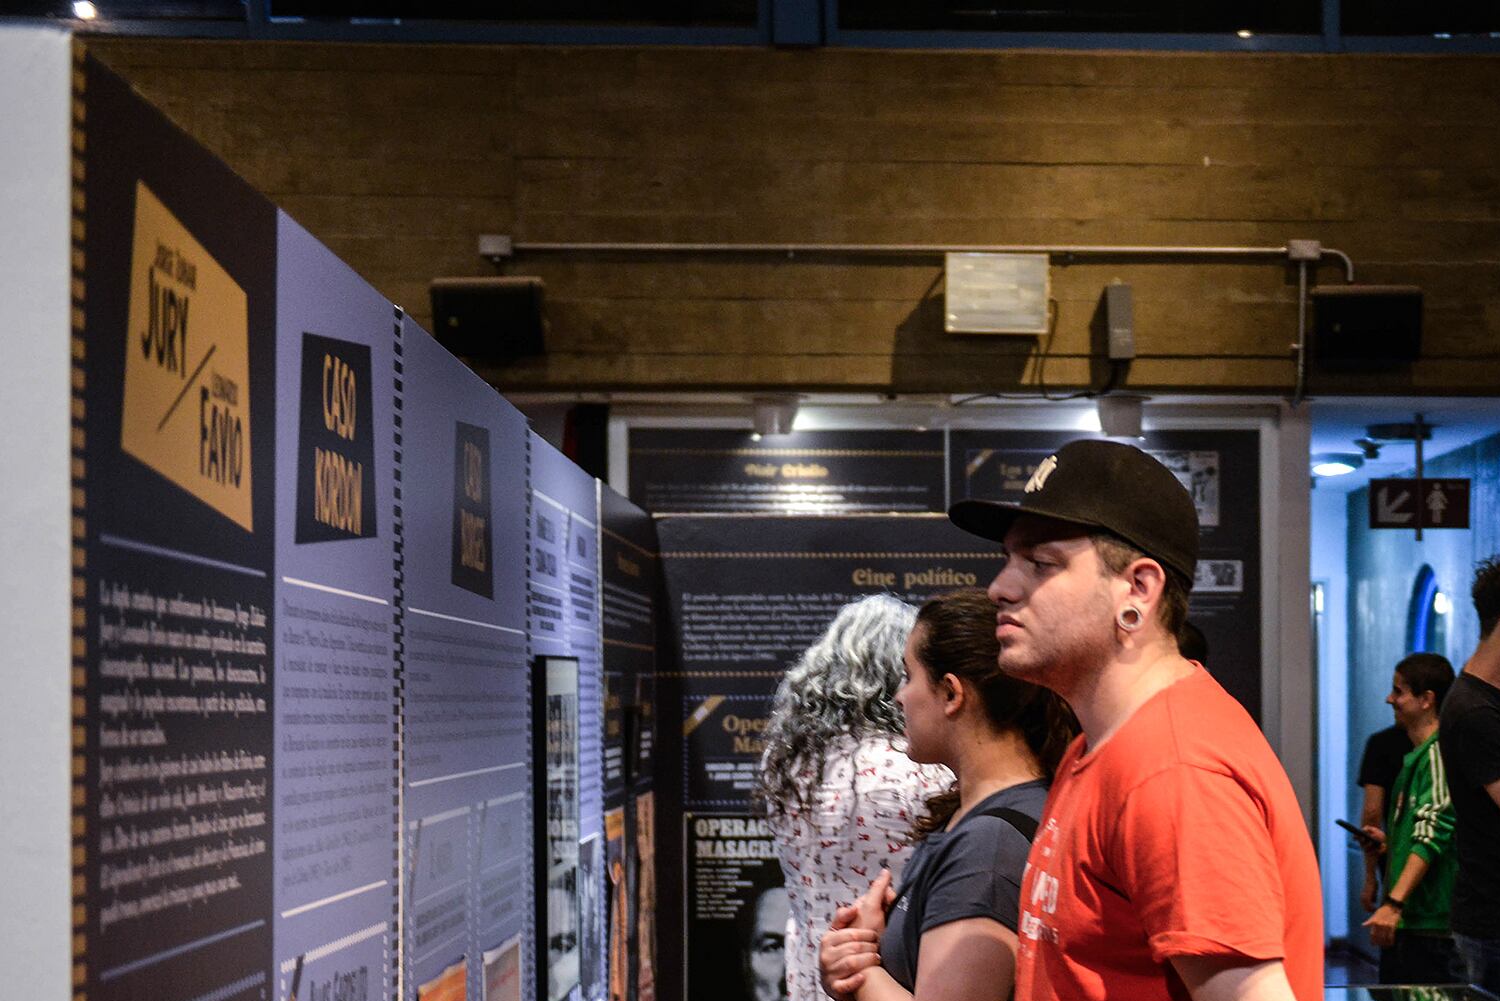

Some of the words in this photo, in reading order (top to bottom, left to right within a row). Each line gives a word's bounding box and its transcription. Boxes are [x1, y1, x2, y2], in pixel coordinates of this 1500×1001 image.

[141, 265, 188, 380] JURY
[200, 384, 243, 489] FAVIO
[322, 353, 356, 441] CASO
[852, 568, 897, 586] Cine
[904, 567, 978, 590] político
